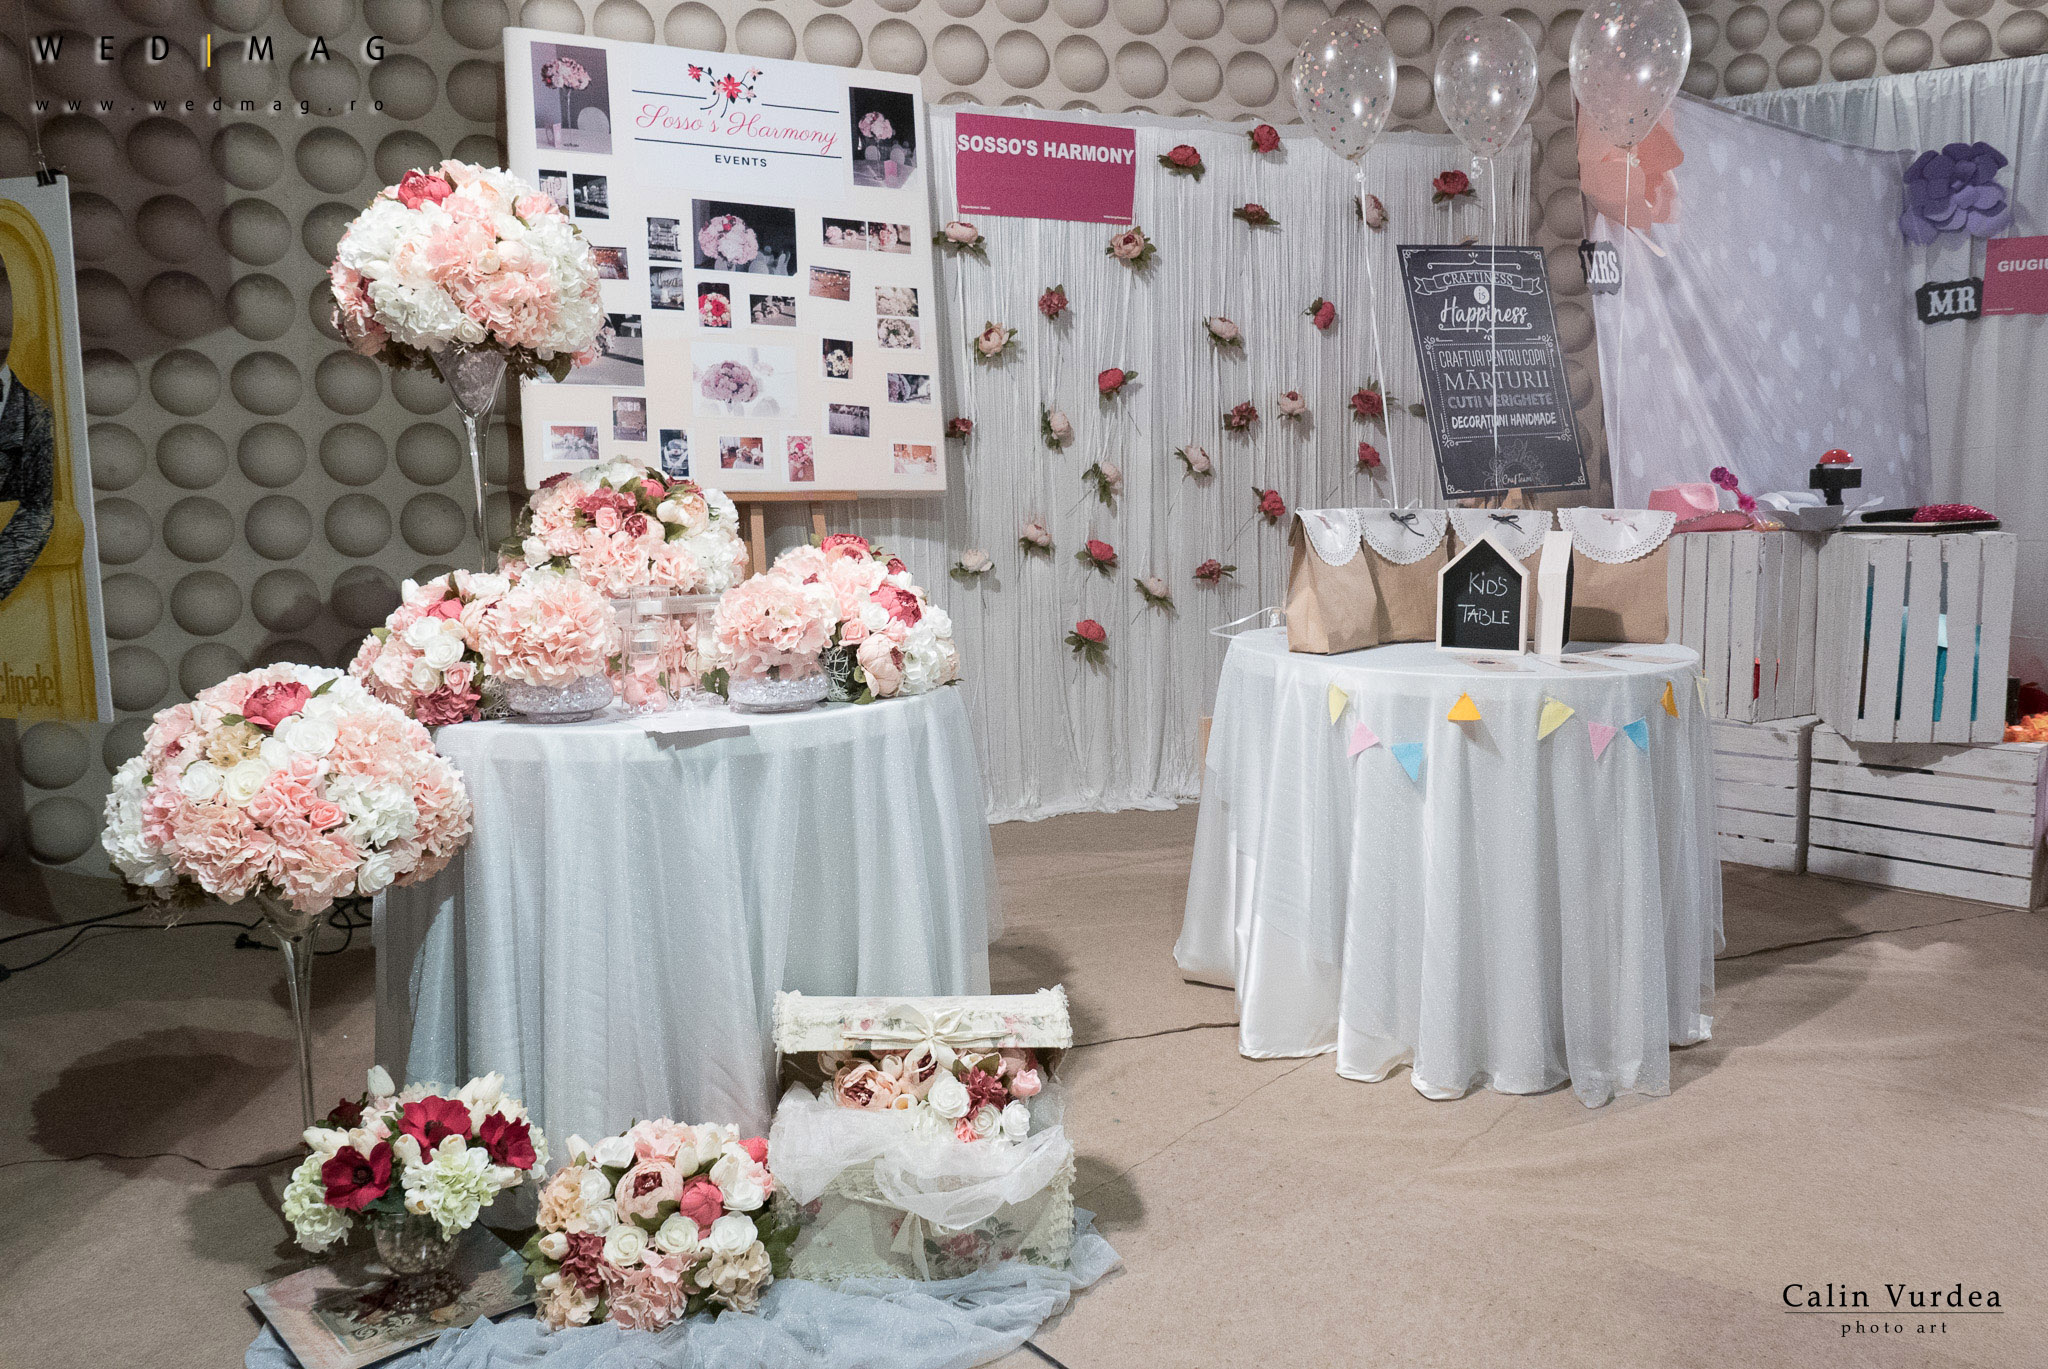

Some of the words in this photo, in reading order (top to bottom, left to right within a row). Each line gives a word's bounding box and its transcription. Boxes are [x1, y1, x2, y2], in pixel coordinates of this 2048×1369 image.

[635, 103, 719, 133] Sosso's
[726, 111, 838, 155] Harmony
[957, 133, 1038, 157] SOSSO'S
[1043, 141, 1135, 165] HARMONY
[714, 154, 768, 168] EVENTS
[1581, 249, 1620, 284] MRS
[1442, 271, 1514, 286] CRAFTINESS
[1478, 288, 1487, 301] is
[1927, 285, 1978, 317] MR
[1440, 295, 1529, 333] Happiness
[1438, 350, 1486, 368] CRAFTURI
[1522, 348, 1547, 366] COPII
[1447, 395, 1483, 409] CUTII
[1483, 392, 1554, 408] VERIGHETE
[1510, 411, 1557, 428] HANDMADE
[1457, 603, 1511, 626] TABLE
